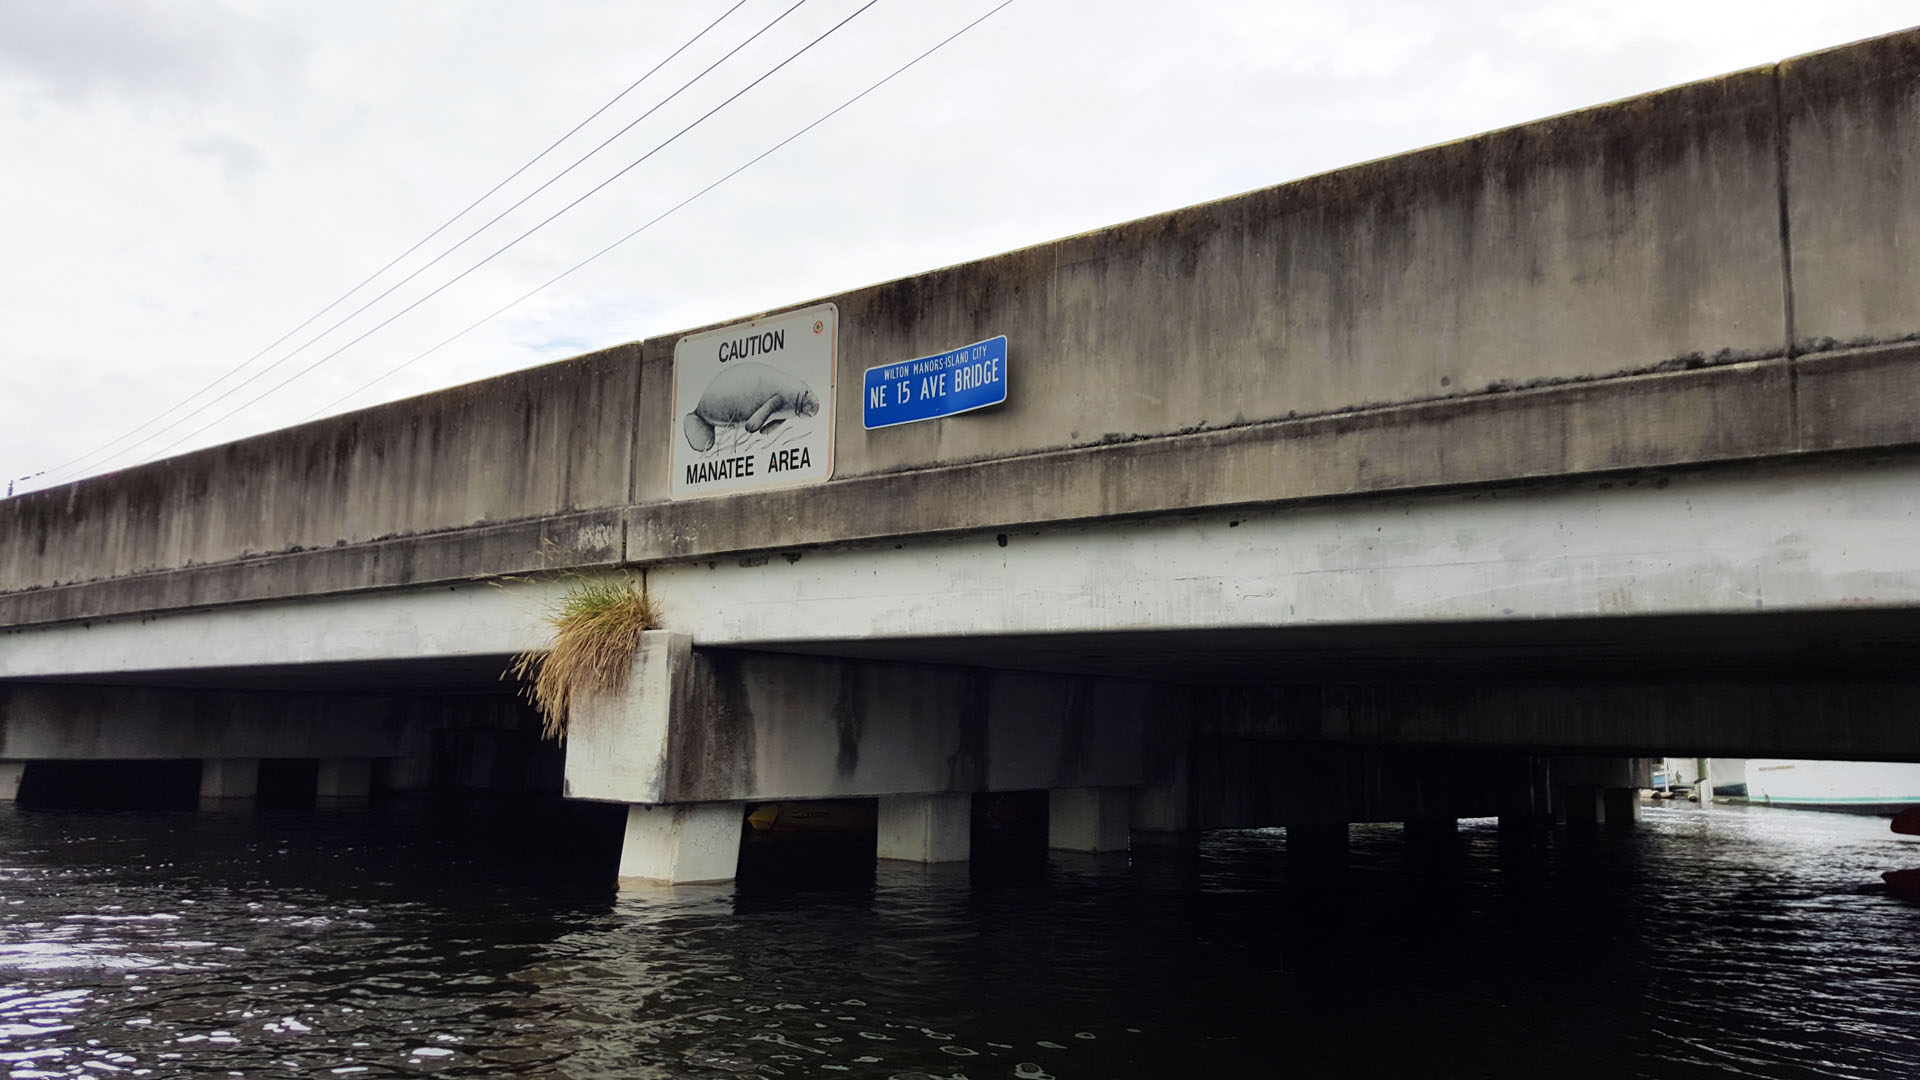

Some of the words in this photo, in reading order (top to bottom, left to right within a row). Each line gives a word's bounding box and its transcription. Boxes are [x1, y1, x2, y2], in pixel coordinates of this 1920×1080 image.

[718, 329, 785, 362] CAUTION
[884, 366, 909, 381] WILTON
[972, 345, 987, 360] CITY
[870, 385, 887, 409] NE
[897, 380, 910, 404] 15
[920, 373, 946, 400] AVE
[954, 358, 999, 392] BRIDGE
[686, 455, 755, 485] MANATEE
[767, 447, 811, 473] AREA
